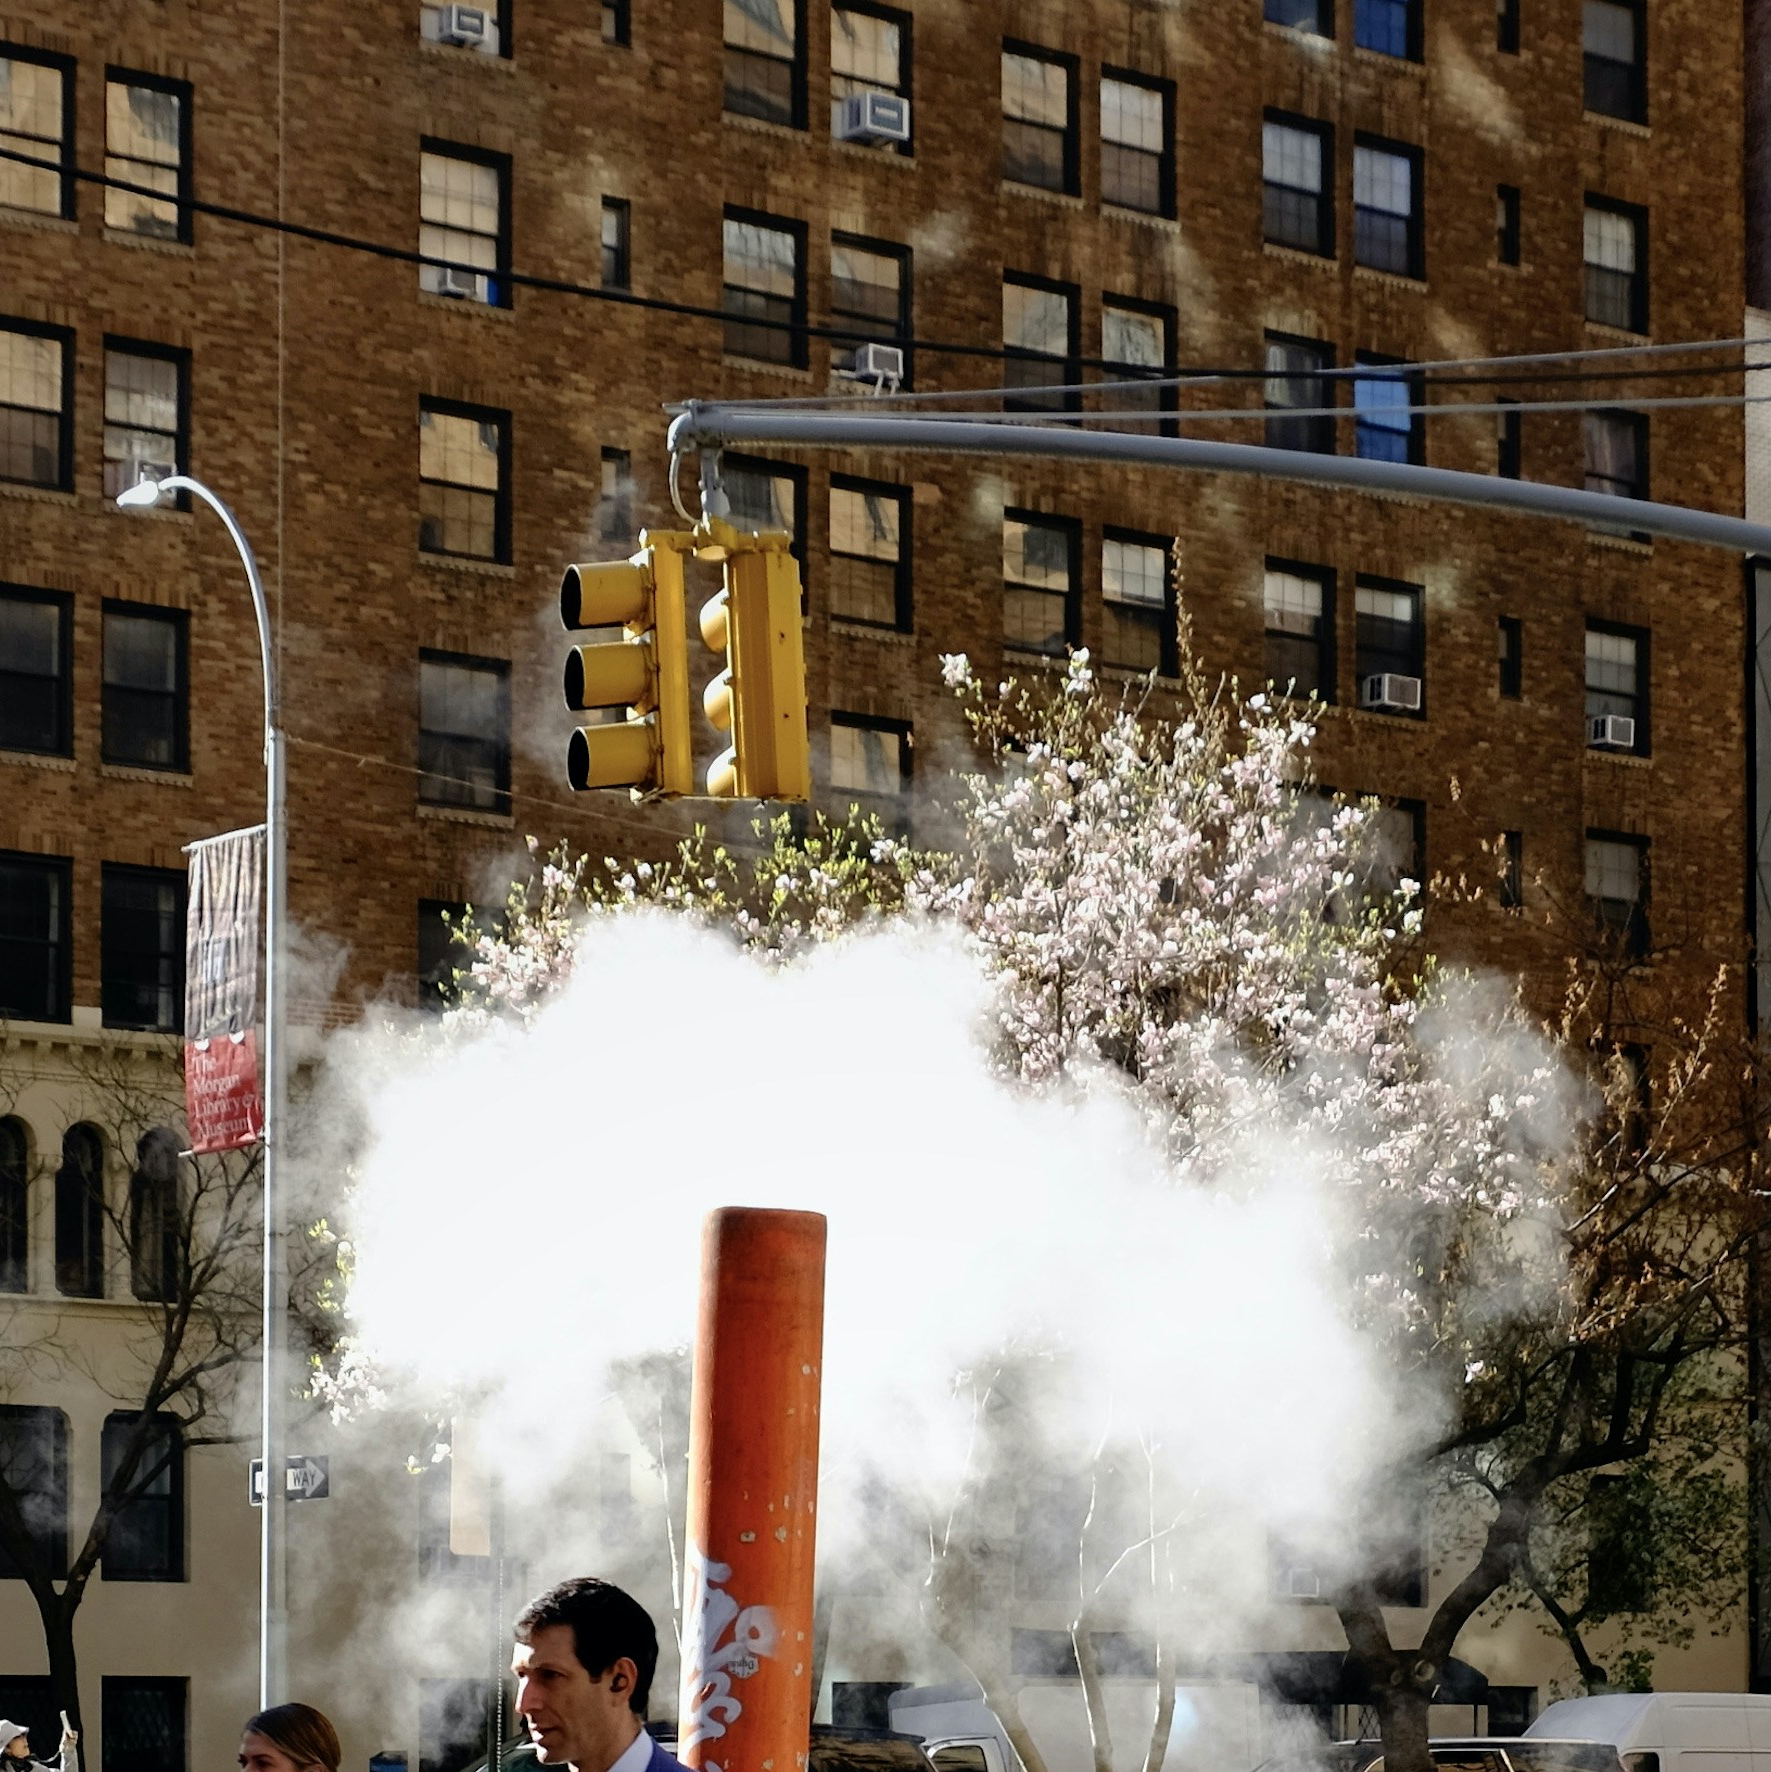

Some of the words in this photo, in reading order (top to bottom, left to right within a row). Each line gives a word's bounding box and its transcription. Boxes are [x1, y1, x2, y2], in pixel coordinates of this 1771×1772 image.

[191, 1055, 217, 1073] The
[193, 1074, 240, 1096] Morgan
[194, 1097, 240, 1118] Library
[196, 1118, 248, 1140] Museum
[292, 1470, 317, 1487] WAY
